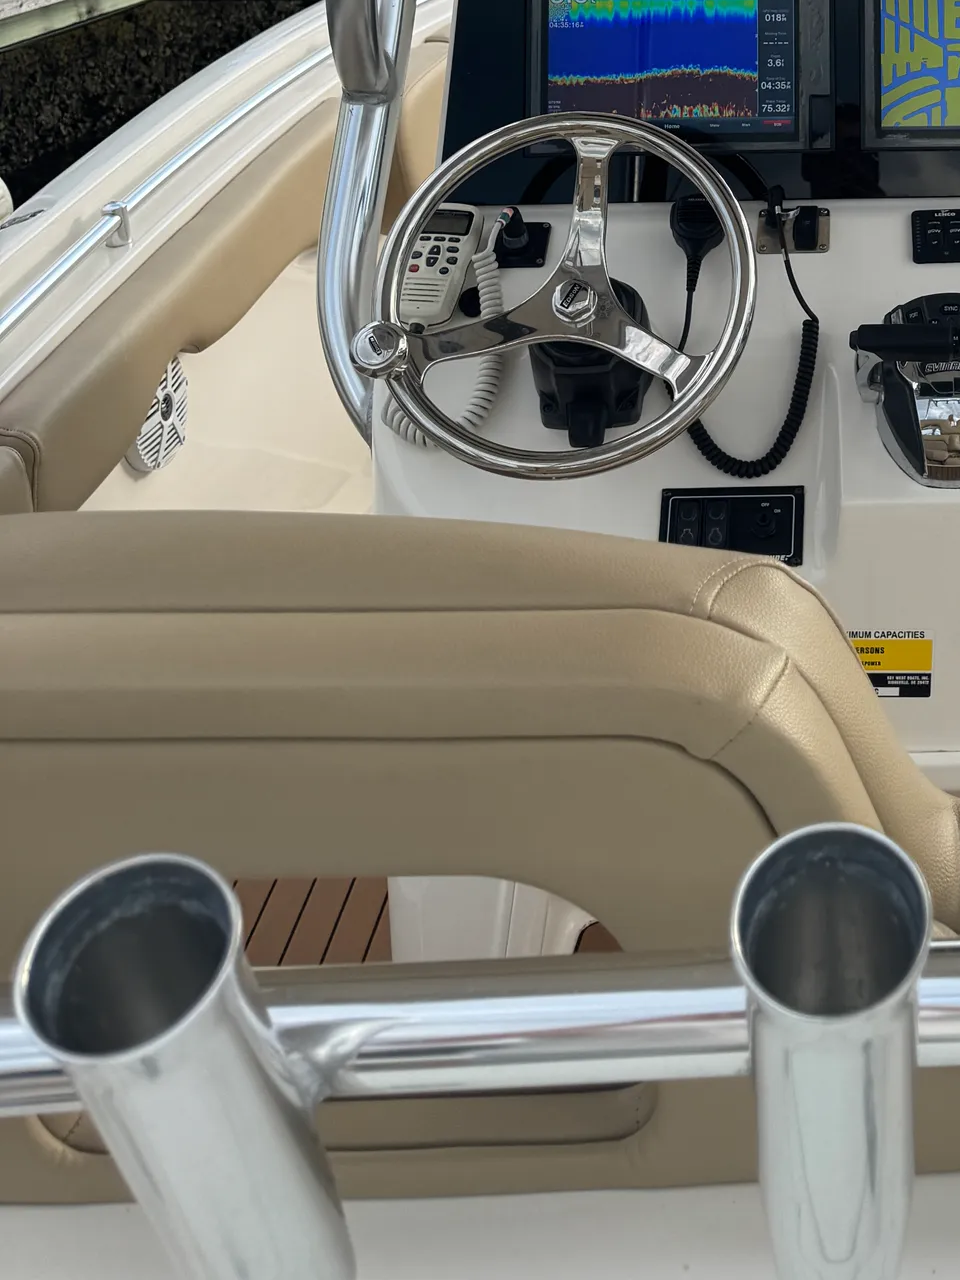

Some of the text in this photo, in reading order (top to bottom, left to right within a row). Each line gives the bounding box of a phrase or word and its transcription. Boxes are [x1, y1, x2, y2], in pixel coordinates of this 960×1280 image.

[760, 81, 787, 90] 04:35
[562, 284, 580, 308] EDSON
[847, 631, 925, 639] IMUM CAPACITIES
